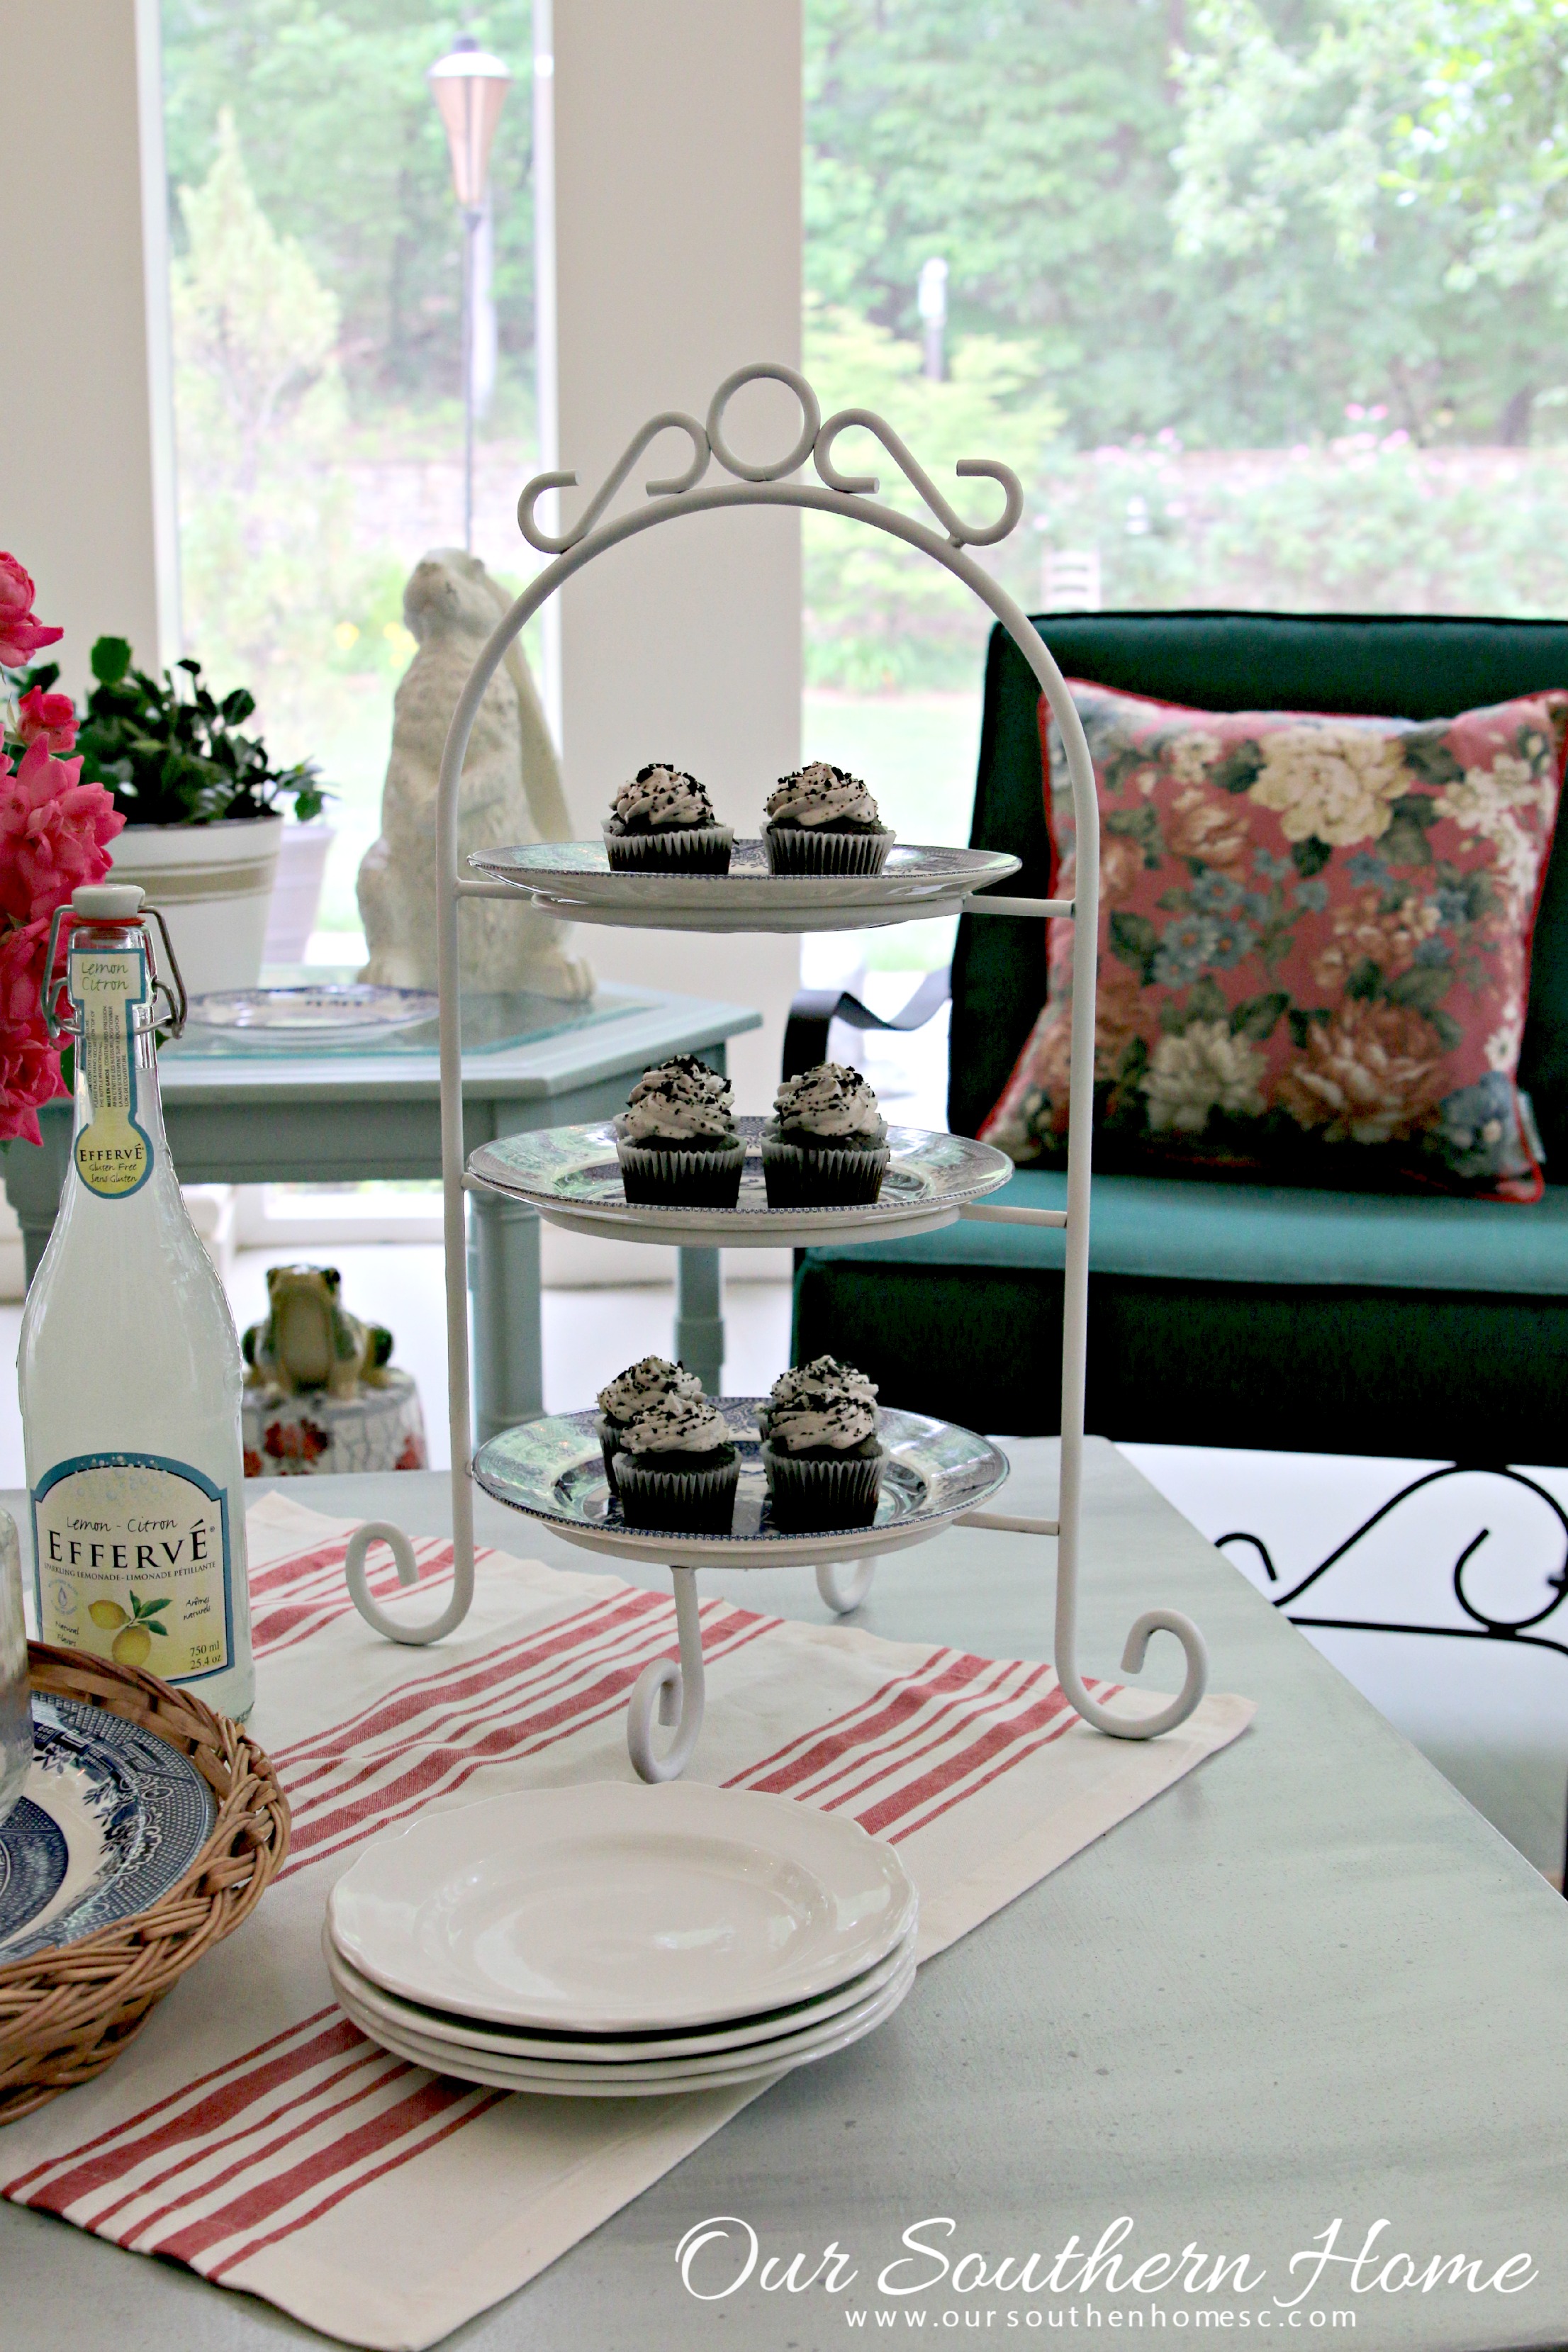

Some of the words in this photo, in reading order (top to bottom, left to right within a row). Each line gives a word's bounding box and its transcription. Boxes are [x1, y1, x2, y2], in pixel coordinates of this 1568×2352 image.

[82, 962, 129, 974] Lemon
[82, 975, 129, 991] Citron
[89, 1163, 115, 1172] Gluten
[91, 1174, 108, 1183] Sans
[110, 1174, 138, 1183] Gluten
[67, 1516, 111, 1533] Lemon
[128, 1516, 178, 1533] Citron
[47, 1518, 208, 1569] EFFERVÉ
[44, 1562, 75, 1577] SPARKLING
[126, 1572, 172, 1581] LIMONADE
[174, 1561, 216, 1577] PÉTILLANTE
[186, 1596, 210, 1607] Arômes
[184, 1604, 211, 1621] naturels
[190, 1645, 207, 1657] 750
[209, 1640, 220, 1652] ml
[190, 1656, 209, 1670] 25.4
[212, 1654, 221, 1664] oz
